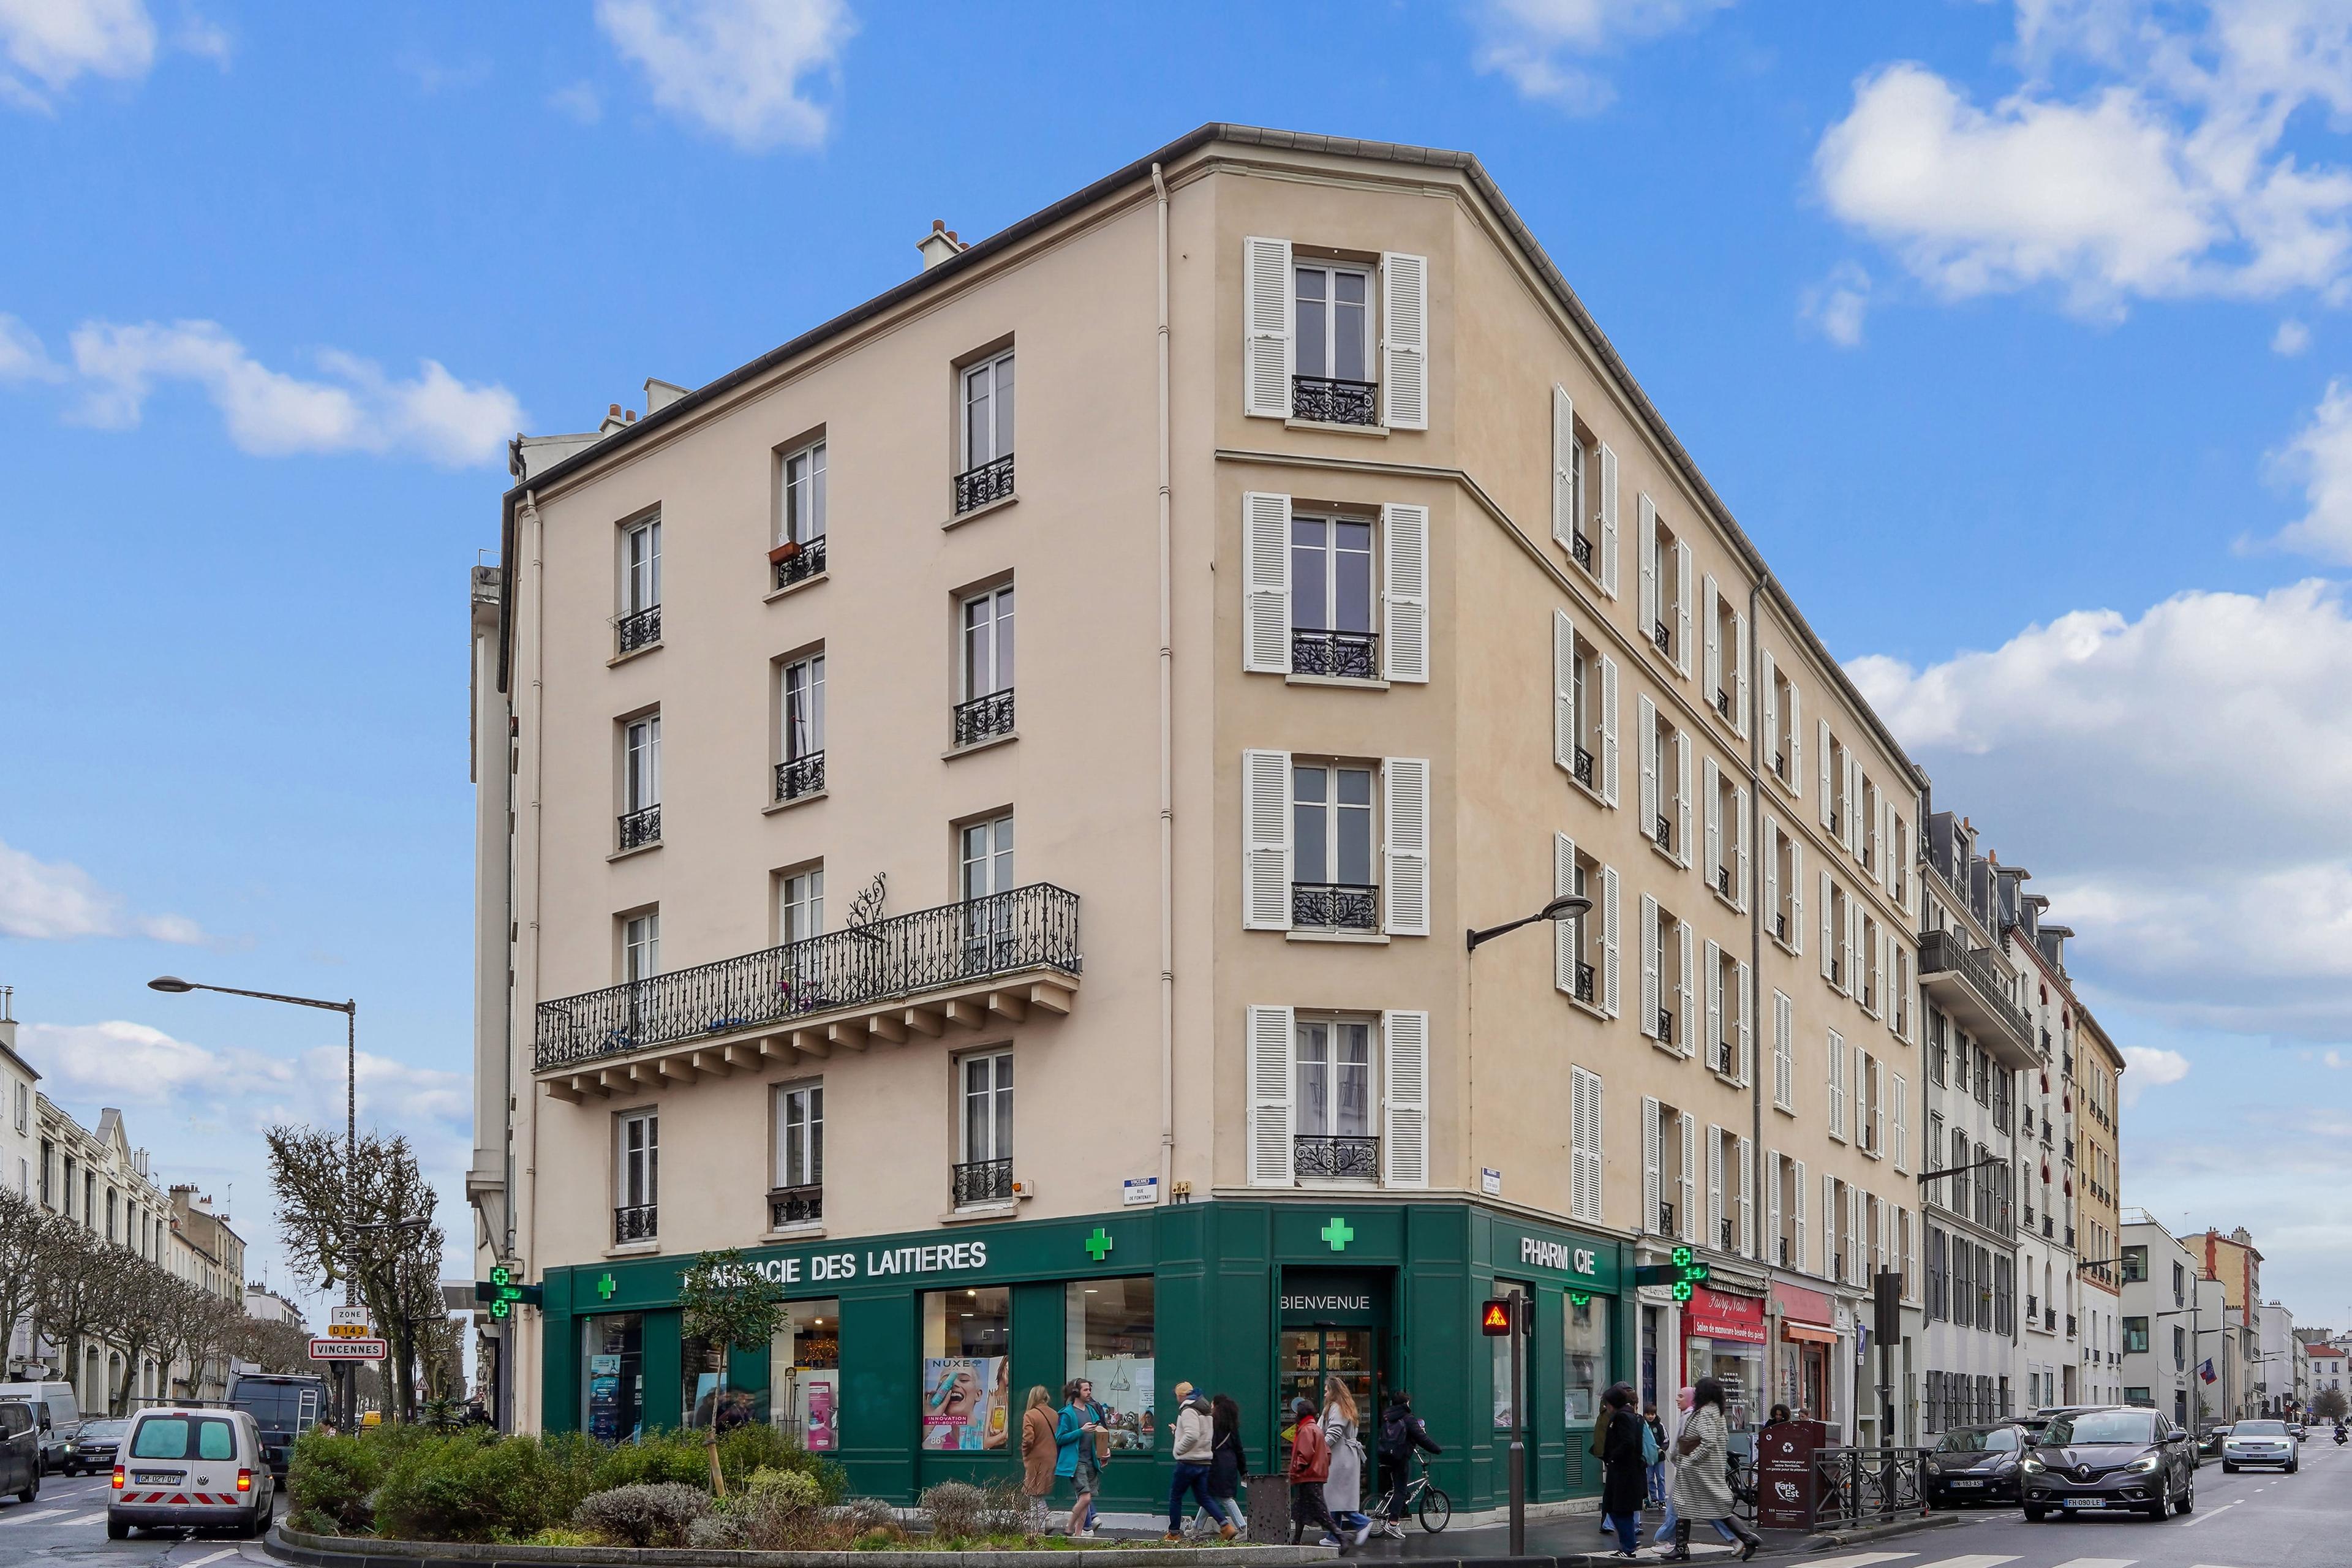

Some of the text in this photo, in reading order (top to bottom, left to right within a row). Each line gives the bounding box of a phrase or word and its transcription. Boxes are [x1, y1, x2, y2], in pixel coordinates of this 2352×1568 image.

[811, 1253, 856, 1281] DES
[867, 1241, 987, 1276] LAITIERES
[1280, 1296, 1370, 1310] BIENVENUE
[343, 1326, 364, 1335] 143
[1697, 1321, 1708, 1332] Salon
[1709, 1323, 1714, 1333] de
[1754, 1330, 1765, 1340] pieds
[1860, 1329, 1864, 1348] P
[317, 1345, 379, 1354] VINCENNES
[1775, 1482, 1795, 1490] Paris
